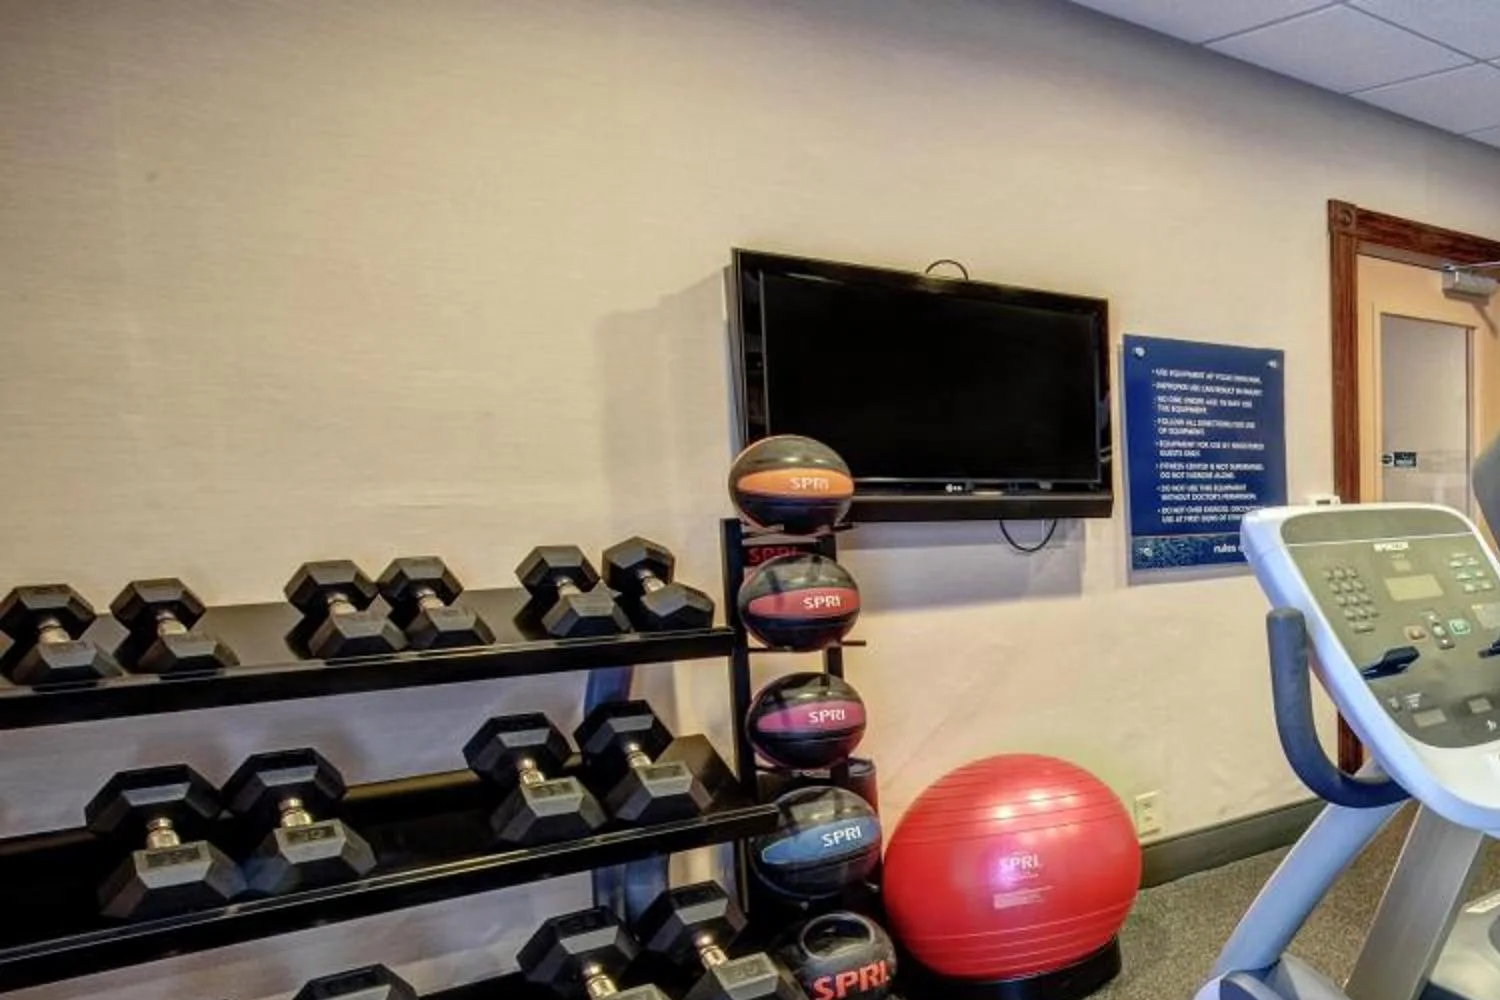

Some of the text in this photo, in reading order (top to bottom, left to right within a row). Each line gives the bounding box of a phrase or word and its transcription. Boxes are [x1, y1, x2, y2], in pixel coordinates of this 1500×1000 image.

[789, 476, 829, 492] SPRI
[803, 595, 841, 609] SPRI
[808, 709, 846, 723] SPRI
[822, 826, 862, 848] SPRI
